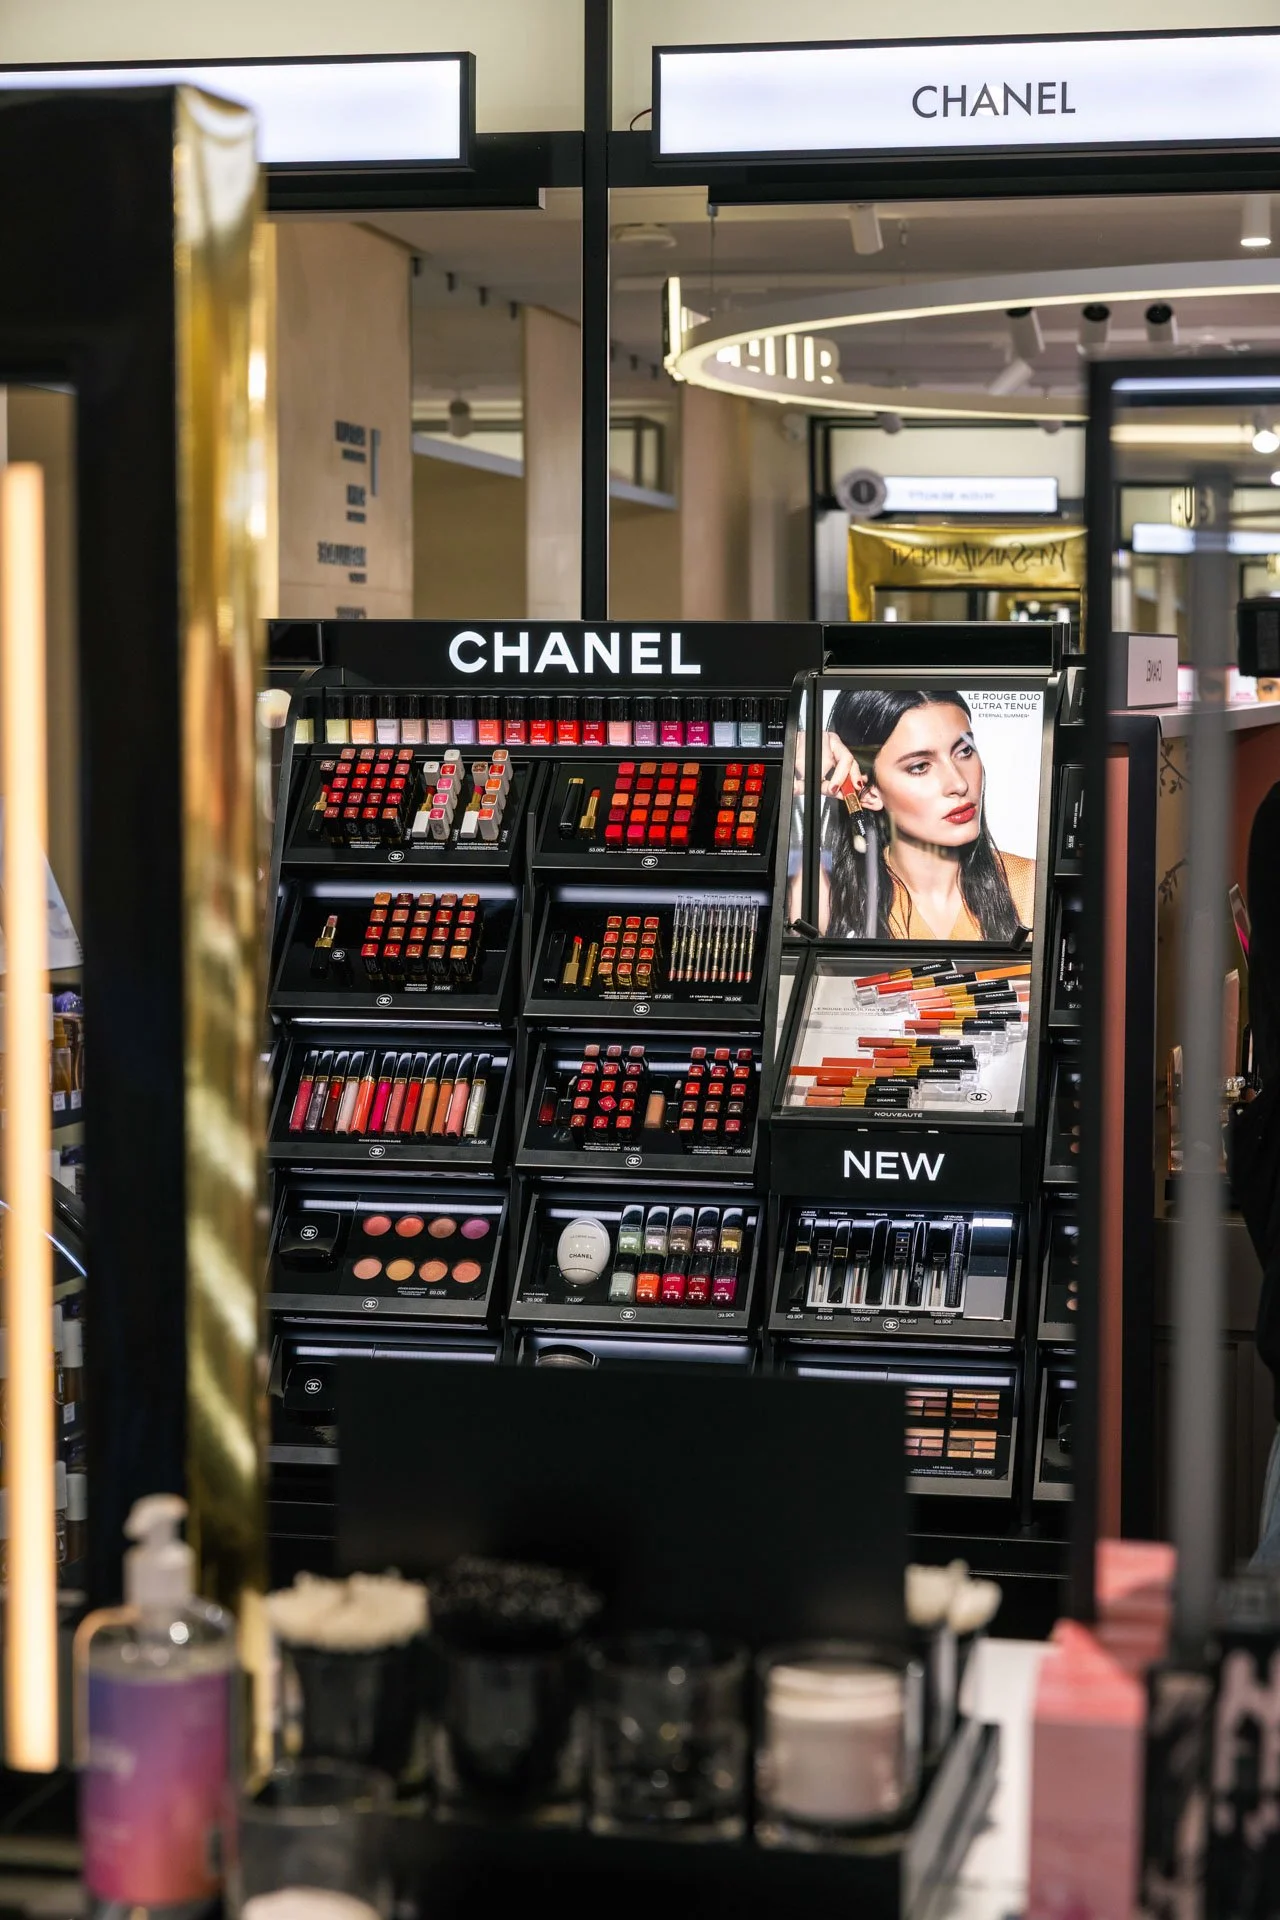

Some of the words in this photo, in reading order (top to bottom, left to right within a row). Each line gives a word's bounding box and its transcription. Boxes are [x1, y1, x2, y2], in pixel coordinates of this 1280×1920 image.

[912, 81, 1076, 119] CHANEL
[448, 631, 701, 675] CHANEL
[982, 693, 1017, 701] ROUGE
[1019, 693, 1041, 701] DUO
[843, 1150, 945, 1181] NEW
